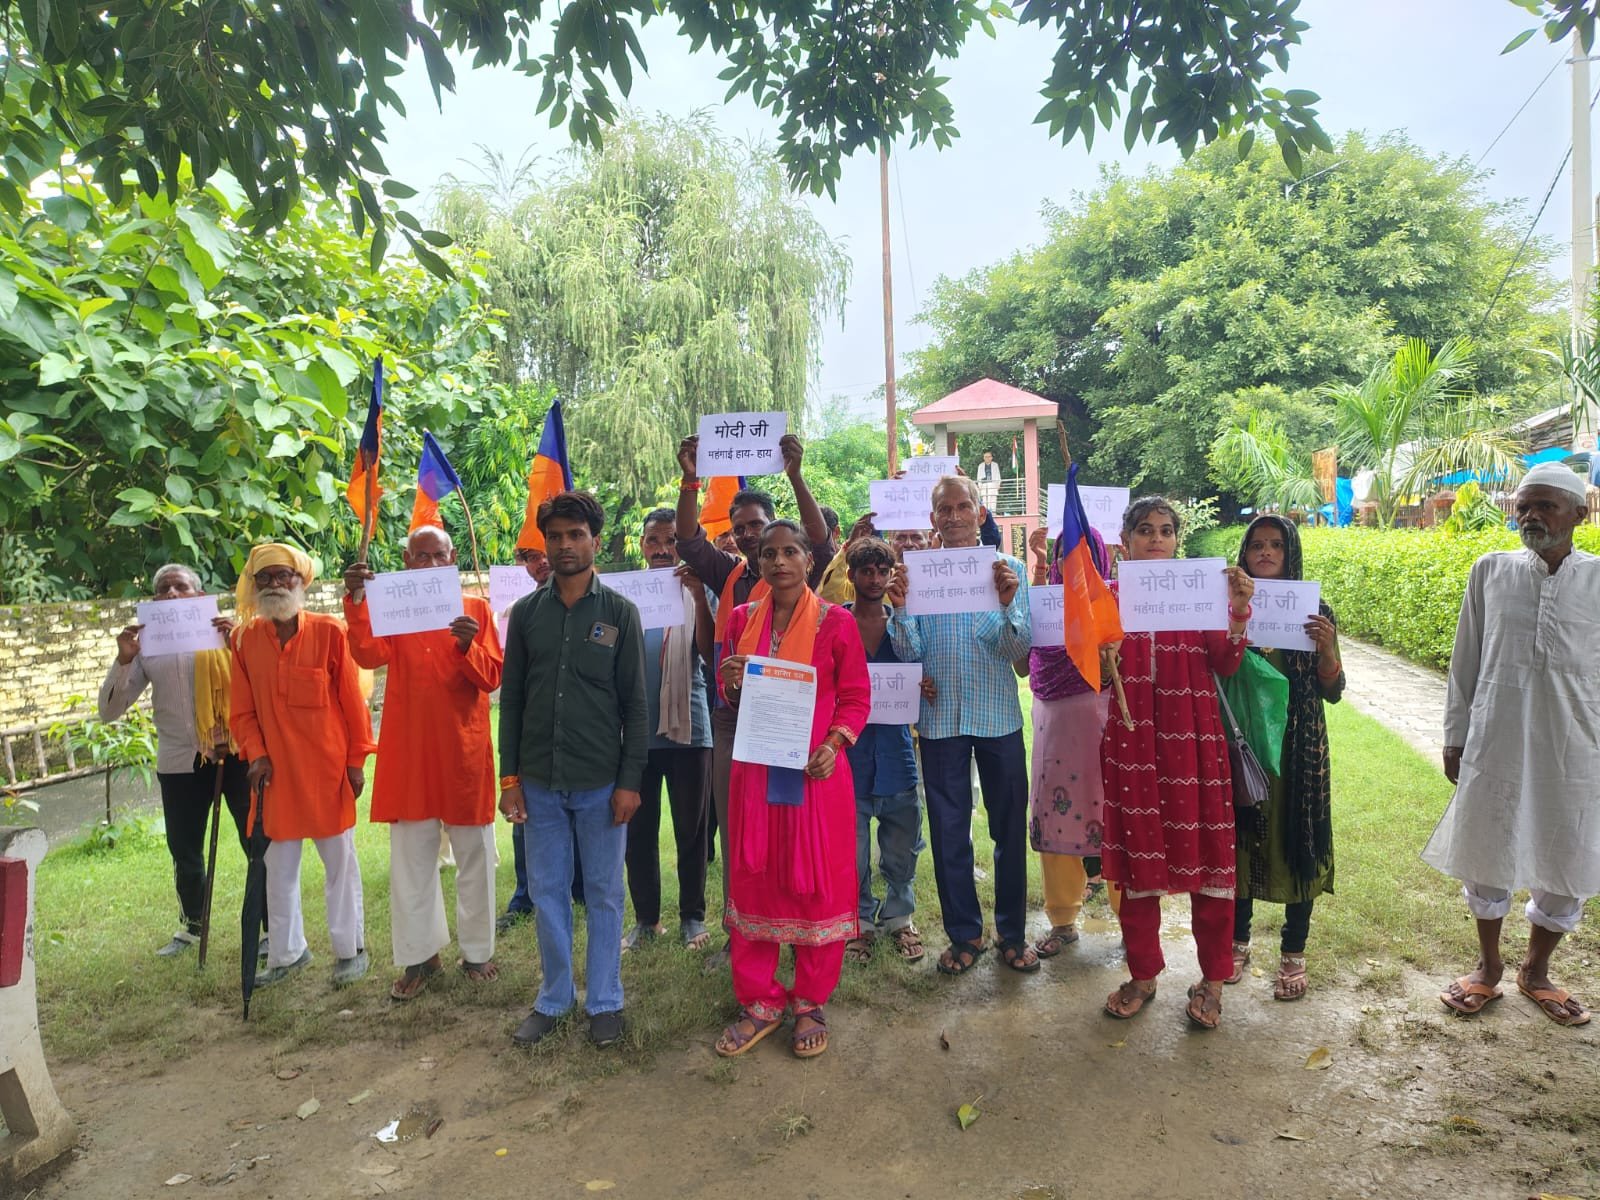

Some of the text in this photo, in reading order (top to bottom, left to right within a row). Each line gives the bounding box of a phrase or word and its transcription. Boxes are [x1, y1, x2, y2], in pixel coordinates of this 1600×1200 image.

[715, 419, 770, 438] मोदी जी
[708, 448, 773, 460] महंगाई हाय- हाय
[883, 486, 930, 502] मोदी जी
[921, 556, 980, 577] मोदी जी
[384, 577, 442, 599] मोदी जी
[645, 577, 665, 594] जी
[1139, 569, 1208, 591] मोदी जी
[917, 586, 945, 599] महंगाई
[969, 586, 985, 596] हाय
[1275, 590, 1299, 610] जी
[150, 606, 202, 624] मोदी जी
[1135, 602, 1168, 615] महंगाई
[1194, 602, 1215, 613] हाय
[886, 672, 907, 690] जी
